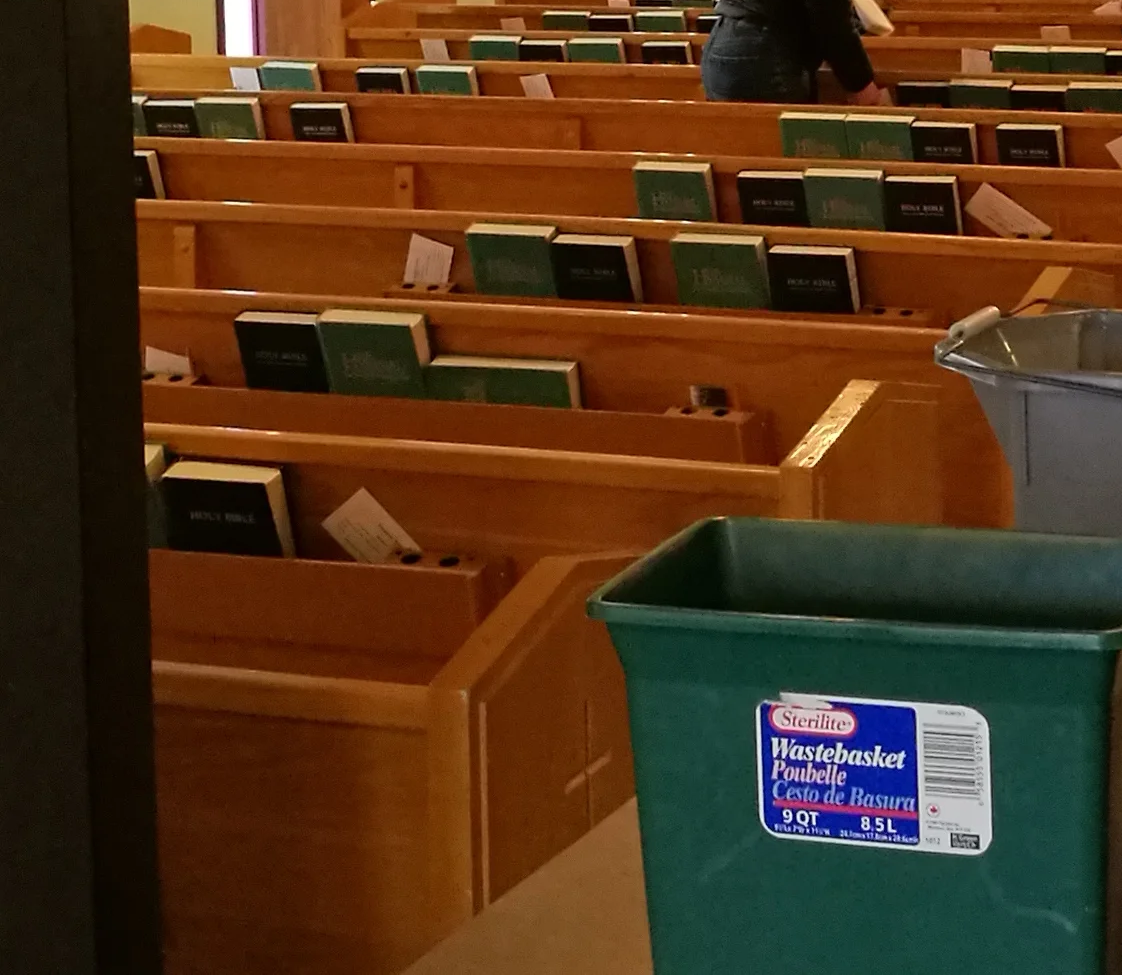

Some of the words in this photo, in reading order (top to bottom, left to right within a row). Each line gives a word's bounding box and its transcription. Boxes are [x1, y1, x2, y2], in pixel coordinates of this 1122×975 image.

[781, 710, 847, 730] Sterilite
[771, 737, 907, 770] Wastebasket
[771, 760, 847, 786] Poubelle
[772, 781, 820, 804] Cesto
[823, 783, 845, 807] de
[849, 786, 916, 813] Basura
[782, 809, 794, 825] 9
[796, 810, 820, 828] QT
[861, 815, 885, 834] 8.5
[886, 818, 898, 834] L
